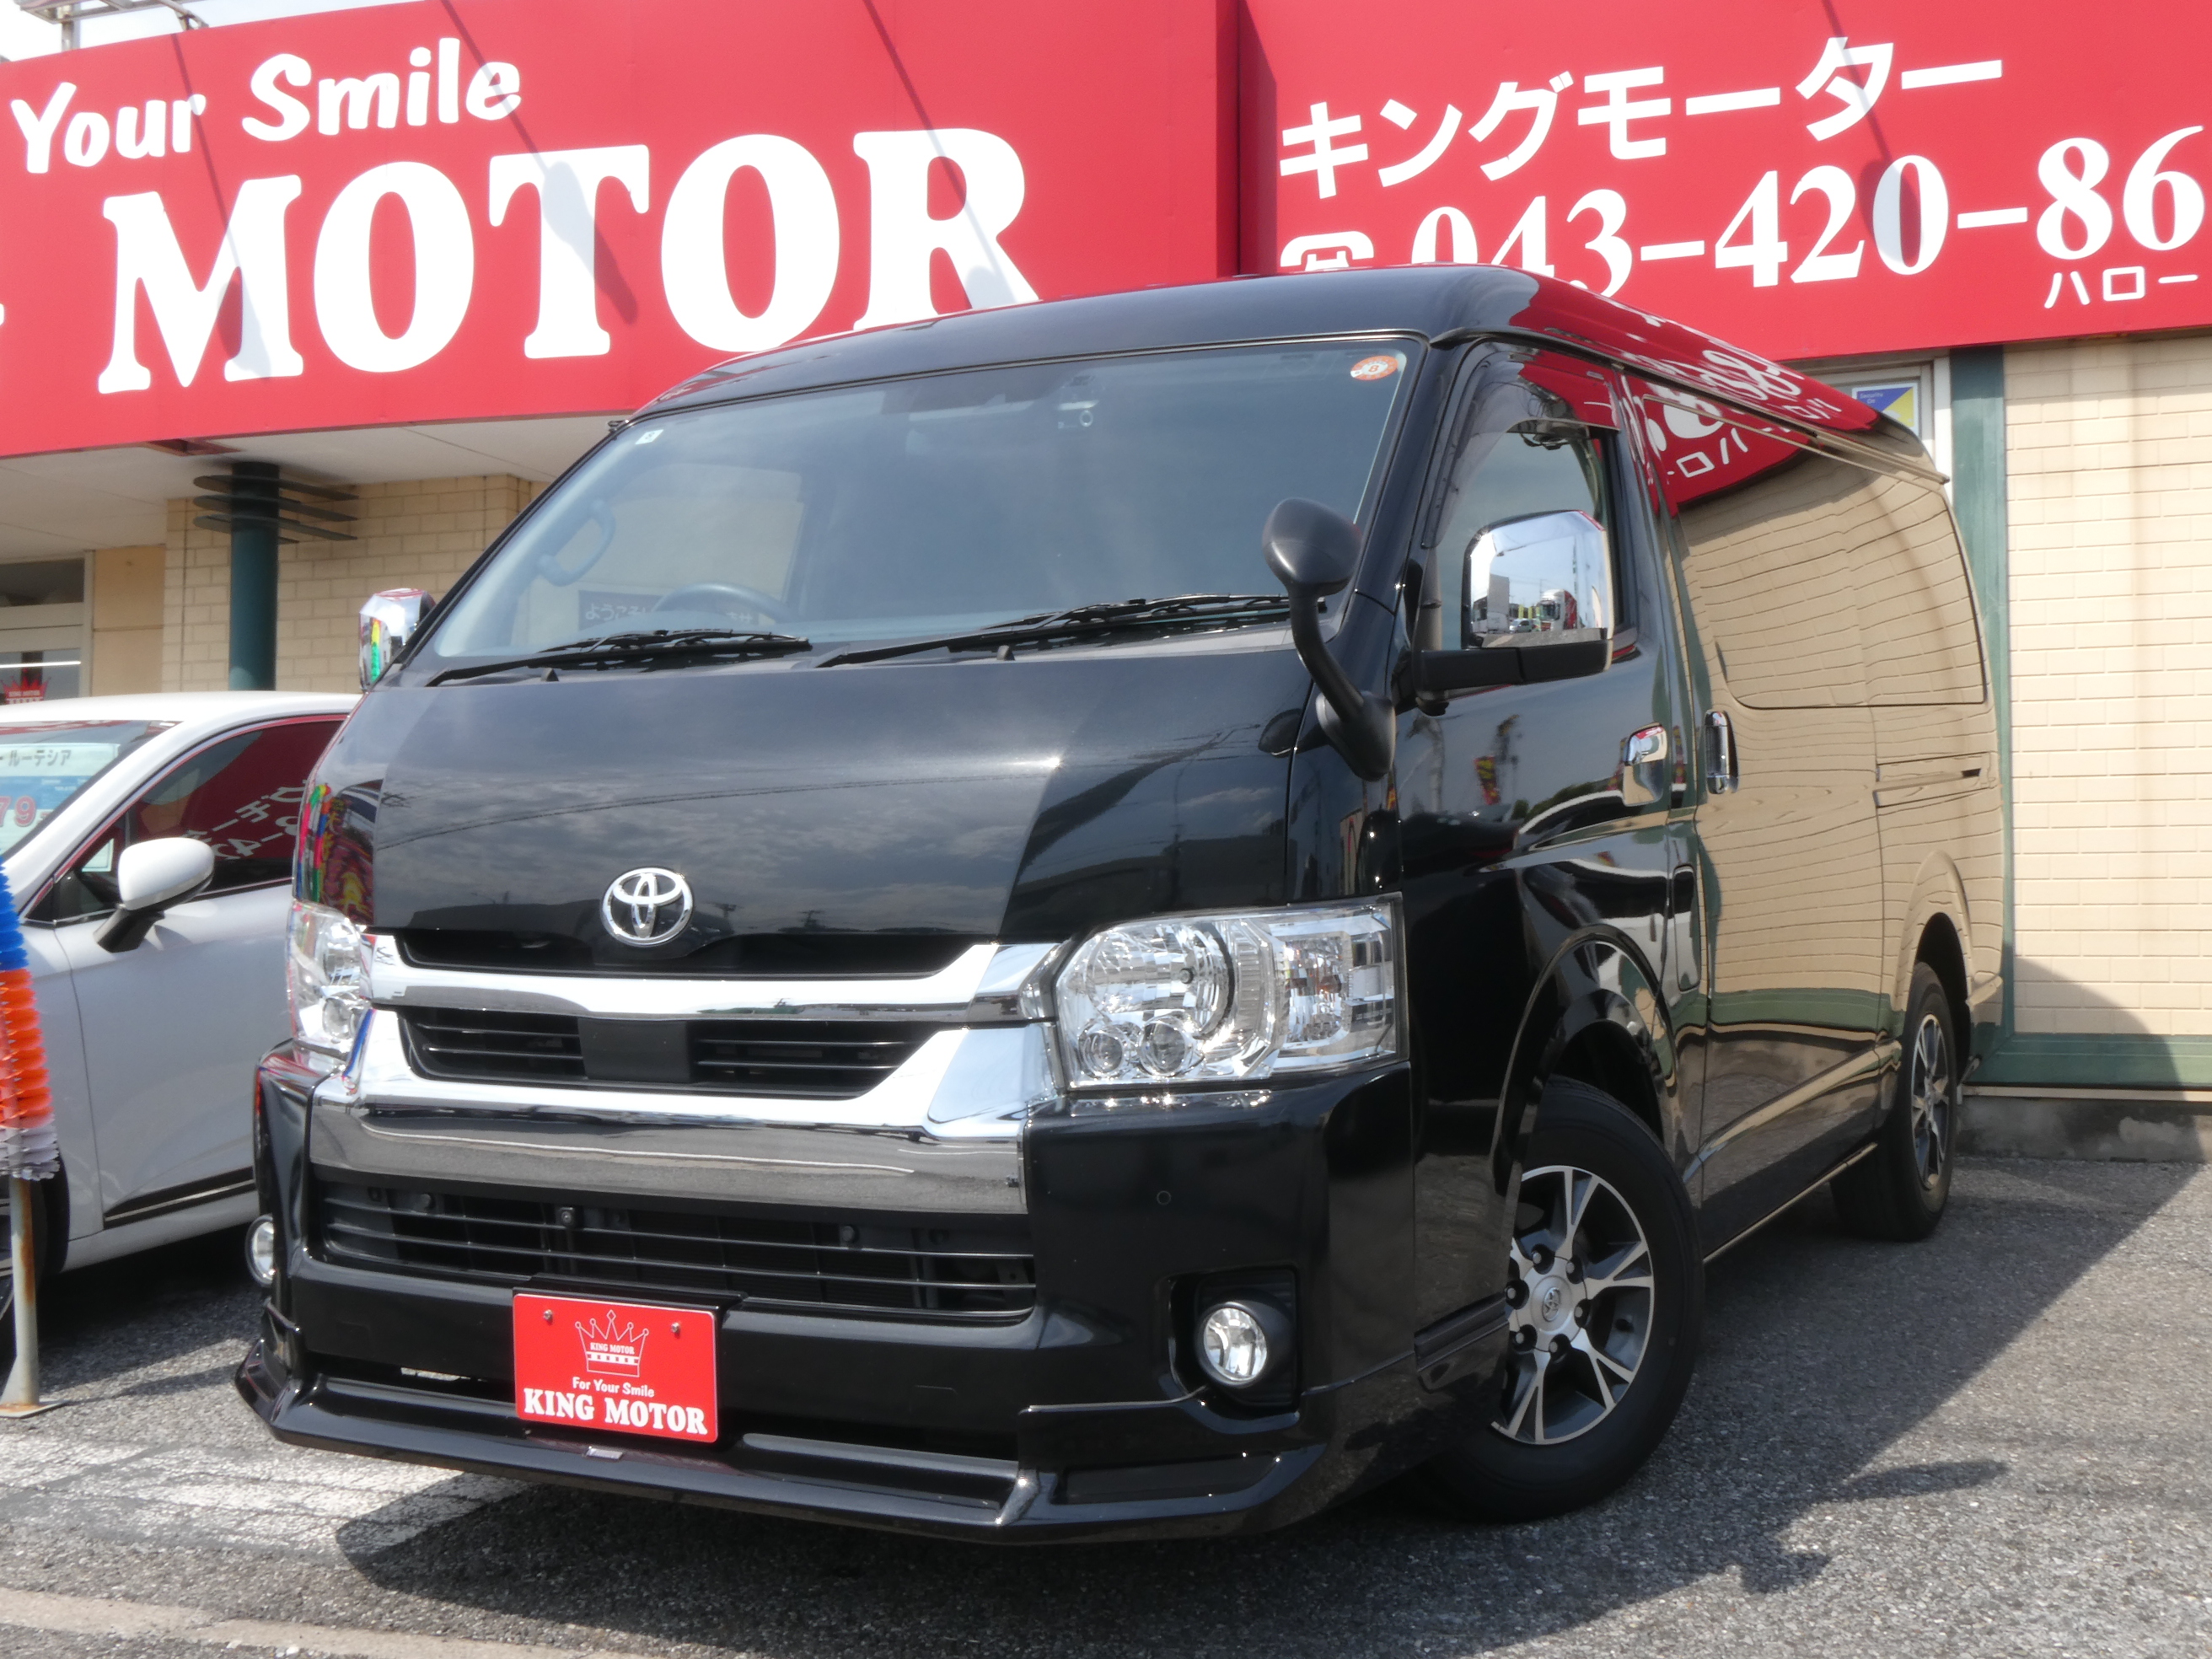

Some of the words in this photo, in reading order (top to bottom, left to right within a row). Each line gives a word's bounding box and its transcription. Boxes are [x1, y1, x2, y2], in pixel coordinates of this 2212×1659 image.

[10, 82, 207, 174] Your
[242, 37, 522, 142] Smile
[1280, 37, 2003, 199] キングモーター
[98, 128, 1042, 394] MOTOR
[2044, 266, 2199, 309] ハロー
[8, 749, 72, 766] ルーテシア
[590, 1342, 608, 1352] KING
[610, 1345, 635, 1355] MOTOR
[572, 1377, 592, 1390] For
[593, 1379, 620, 1393] Your
[622, 1382, 655, 1398] Smile
[523, 1388, 594, 1421] KING
[604, 1398, 708, 1435] MOTOR
